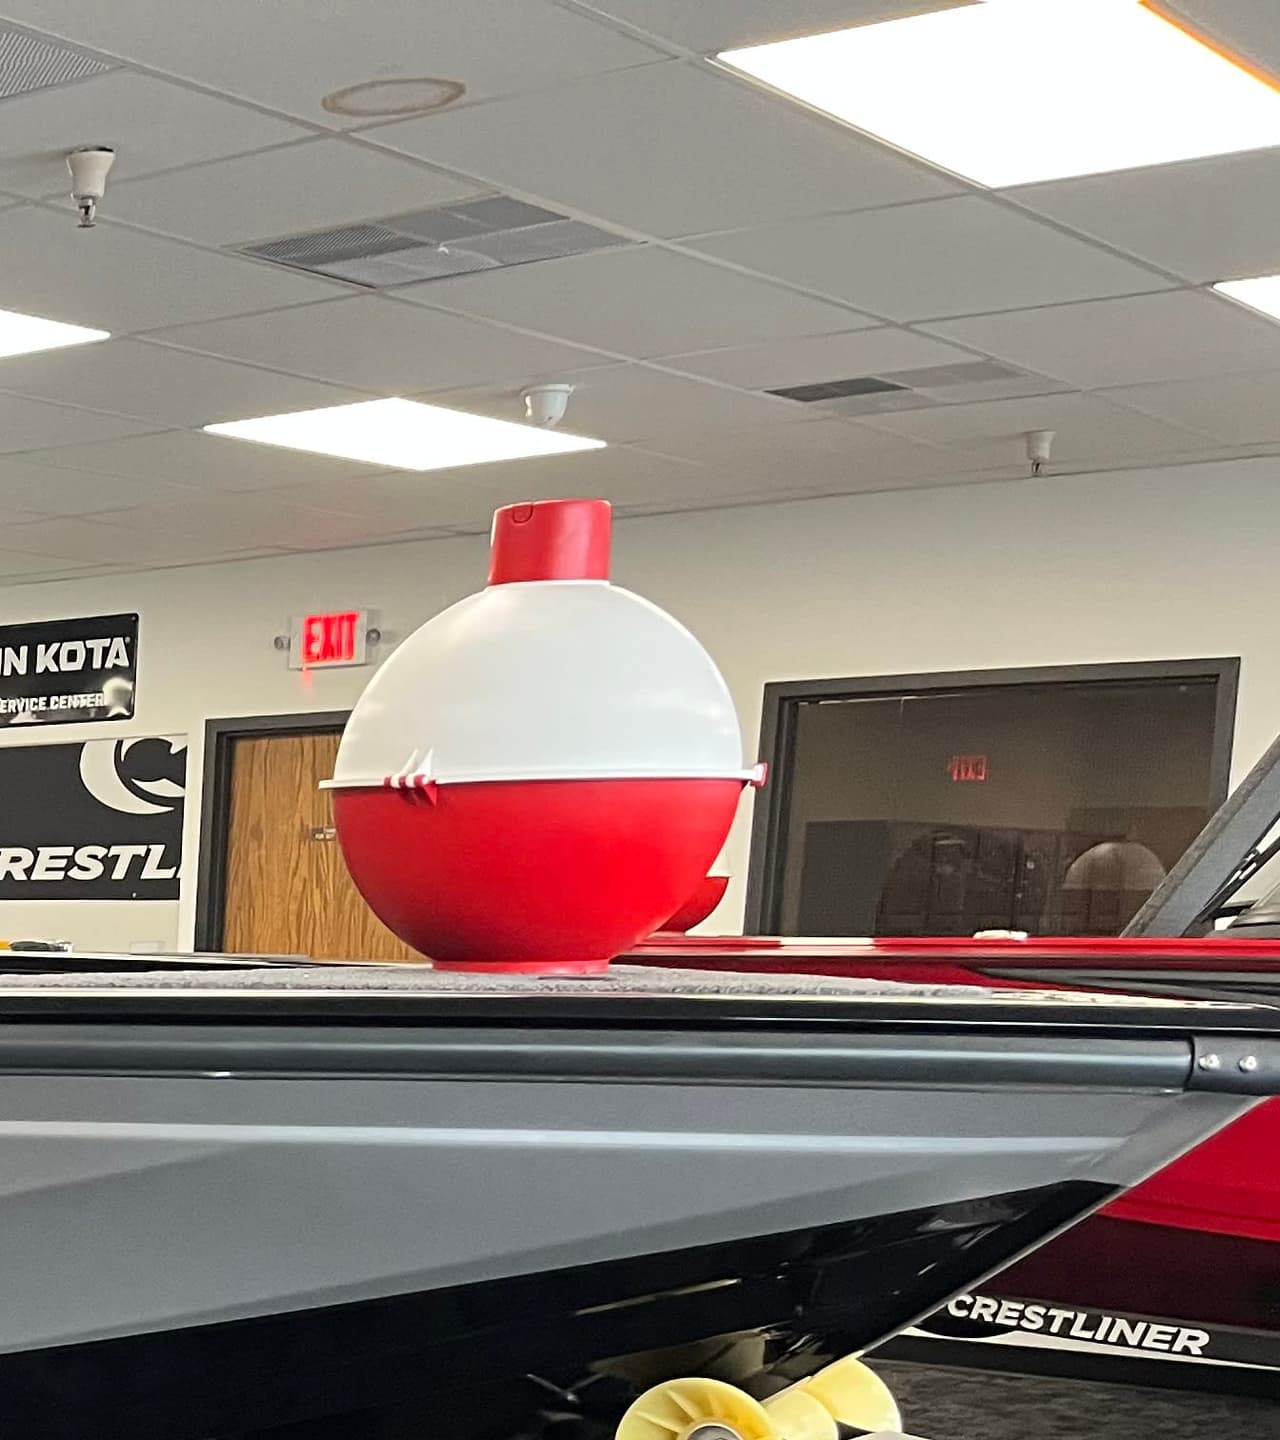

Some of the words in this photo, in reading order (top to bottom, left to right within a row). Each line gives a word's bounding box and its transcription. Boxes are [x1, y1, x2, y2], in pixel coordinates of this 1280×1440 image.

[36, 637, 130, 674] KOTA
[303, 612, 358, 662] EXIT
[49, 693, 105, 711] CENTER
[948, 1294, 1210, 1355] CRESTLINER
